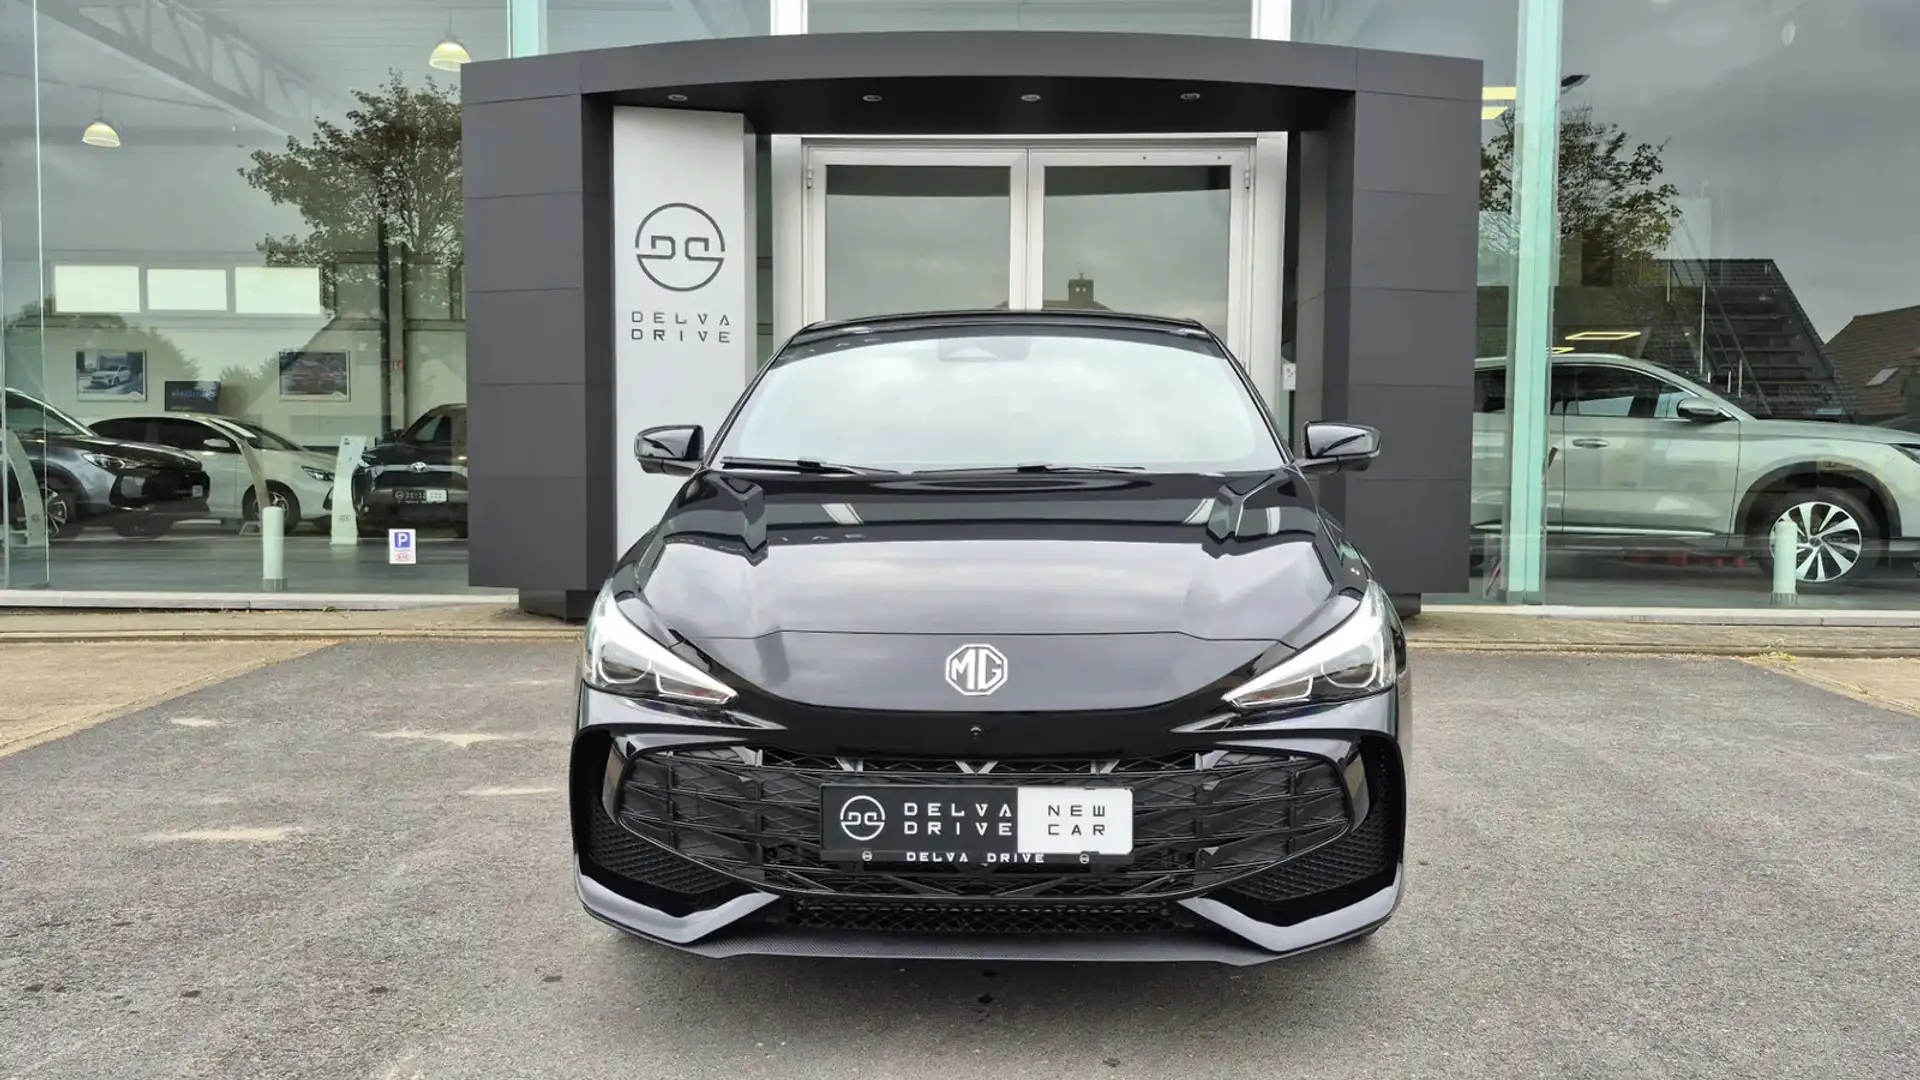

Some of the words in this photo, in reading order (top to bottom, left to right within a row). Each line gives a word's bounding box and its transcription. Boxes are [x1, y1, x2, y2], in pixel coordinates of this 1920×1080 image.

[631, 311, 730, 326] DELVA
[631, 328, 730, 343] DRIVE
[398, 532, 408, 548] P
[951, 649, 1002, 690] MG
[904, 802, 1012, 817] DELVA
[1047, 804, 1105, 817] NEW
[904, 821, 1012, 836] DRIVE
[1047, 824, 1105, 836] CAR
[906, 852, 968, 863] DELVA
[987, 853, 1045, 863] DRIVE
